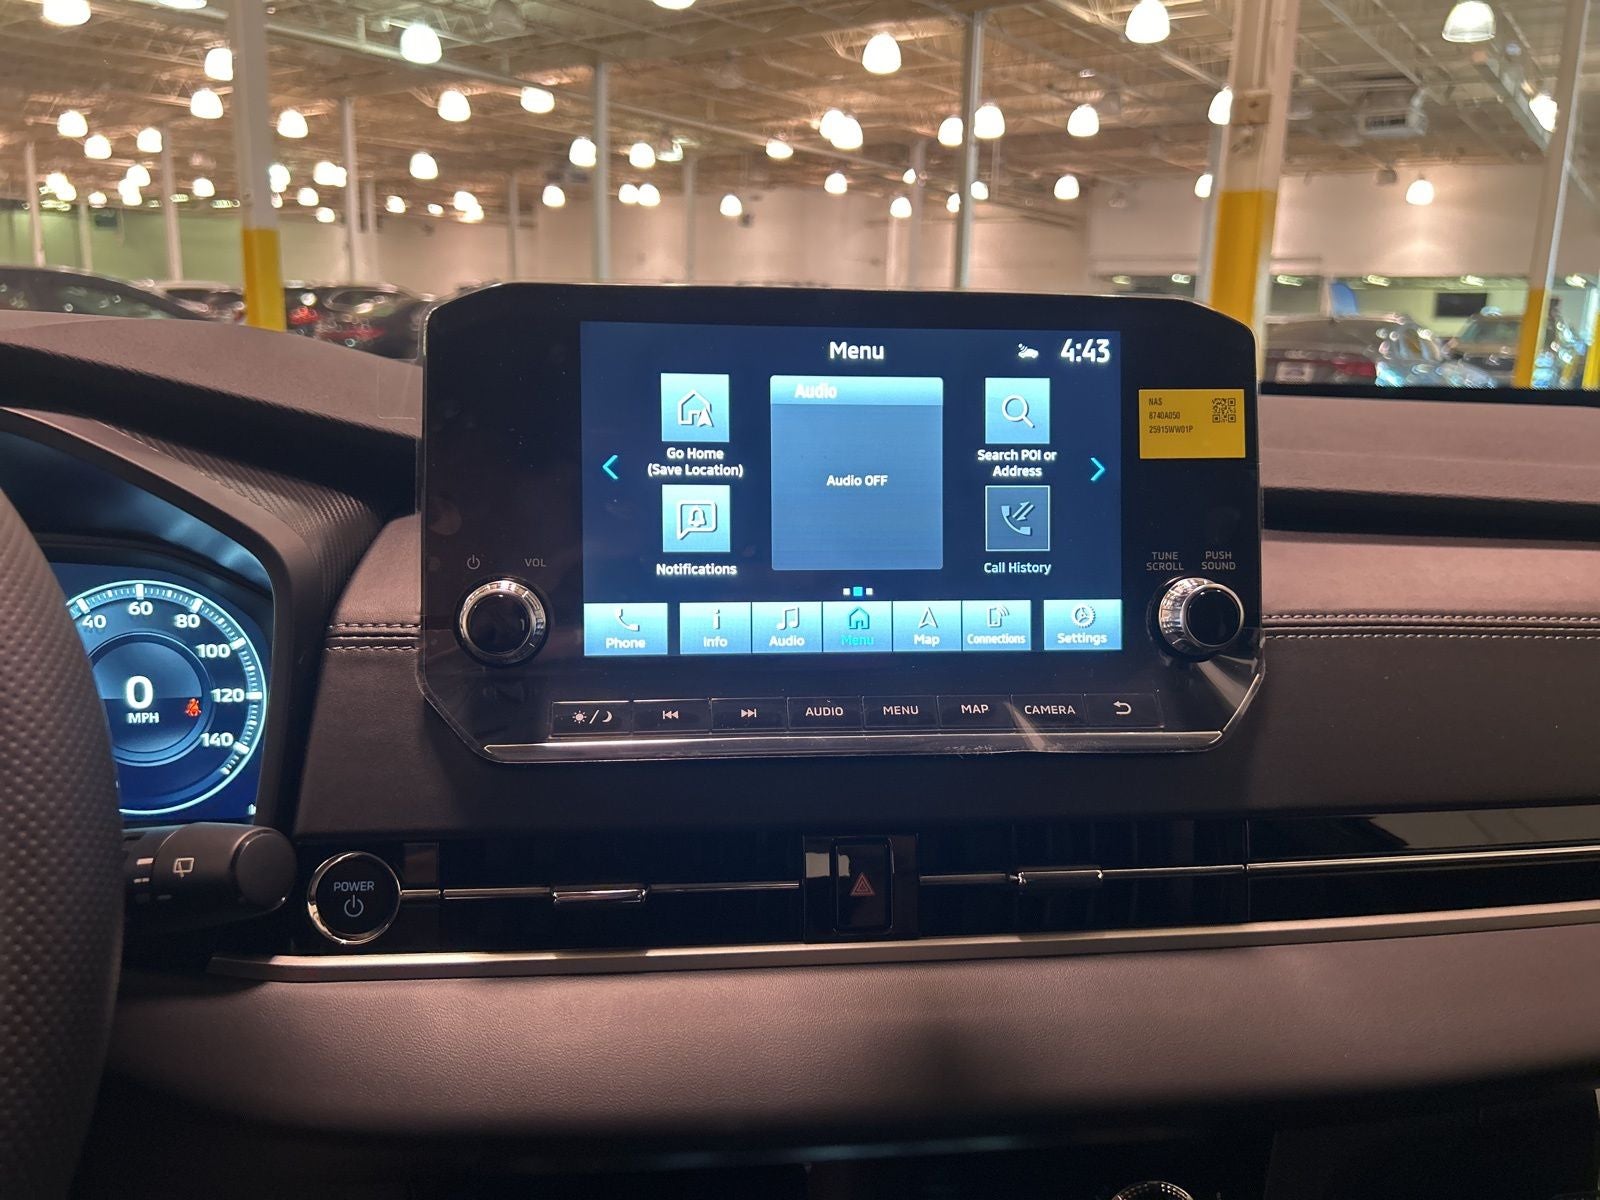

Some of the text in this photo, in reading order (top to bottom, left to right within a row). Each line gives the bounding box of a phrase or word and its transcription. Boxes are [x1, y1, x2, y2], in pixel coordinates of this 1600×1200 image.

[829, 340, 884, 360] Menu
[1060, 338, 1111, 363] 4:43
[795, 383, 837, 399] Audio
[667, 447, 724, 460] Go Home
[977, 448, 1057, 462] Search POI or
[647, 462, 743, 478] (Save Location)
[993, 464, 1042, 478] Address
[826, 474, 888, 487] Audio OFF
[1152, 552, 1178, 560] TUNE
[1206, 551, 1232, 560] PUSH
[524, 558, 546, 567] VOL
[656, 562, 737, 576] Notifications
[984, 561, 1051, 576] Call History
[1201, 562, 1235, 570] SOUND
[128, 602, 153, 615] 60
[82, 615, 107, 628] 40
[175, 615, 200, 628] 80
[605, 637, 646, 649] Phone
[703, 636, 728, 648] Info
[769, 635, 805, 647] Audio
[841, 634, 874, 646] Menu
[913, 633, 940, 648] Map
[967, 632, 1025, 645] Connections
[1057, 631, 1107, 646] Settings
[197, 644, 230, 657] 100
[126, 675, 154, 709] 0
[211, 689, 244, 702] 120
[805, 706, 844, 717] AUDIO
[882, 706, 919, 716] MENU
[961, 704, 990, 714] MAP
[1024, 704, 1076, 715] CAMERA
[128, 713, 159, 723] MPH
[201, 733, 234, 746] 140
[333, 881, 374, 892] POWER
